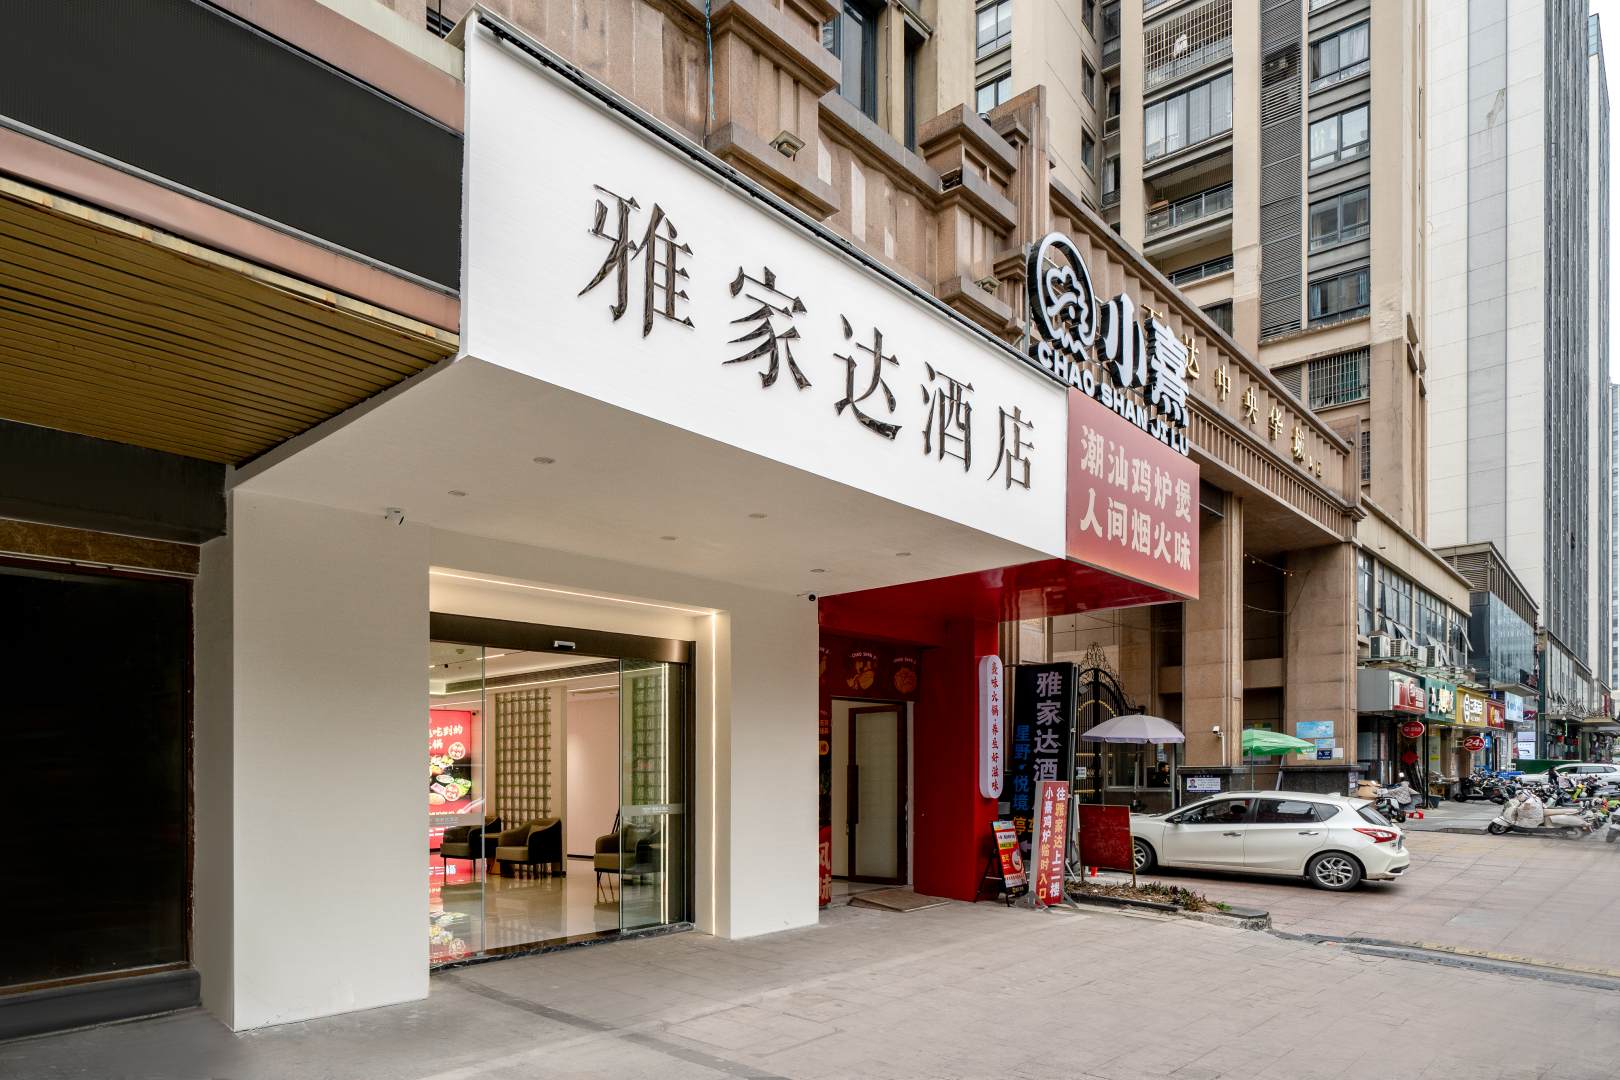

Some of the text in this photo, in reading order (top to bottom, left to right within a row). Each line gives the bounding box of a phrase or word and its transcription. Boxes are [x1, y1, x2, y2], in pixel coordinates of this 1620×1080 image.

[577, 184, 1035, 490] 雅家达酒店
[1037, 340, 1190, 457] CHAO SHAN JI LU
[1080, 425, 1192, 523] 潮汕鸡炉煲
[1080, 487, 1192, 571] 人间烟火味
